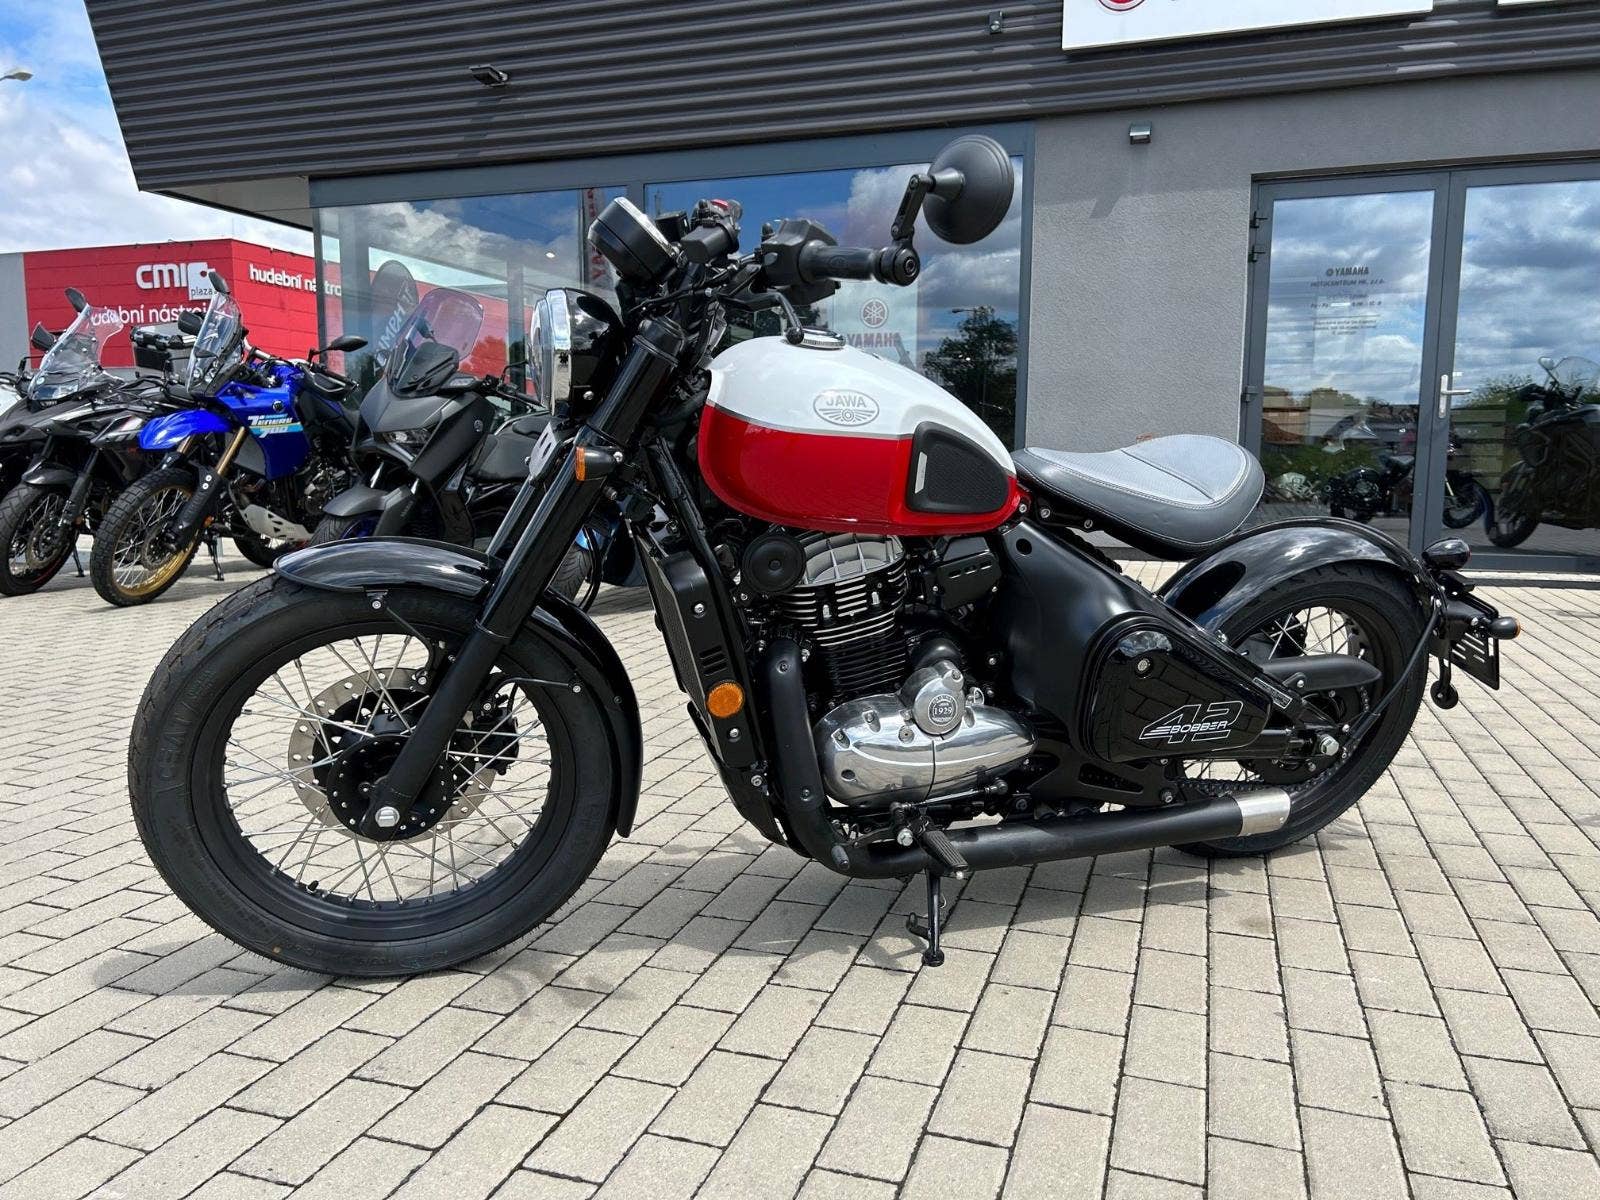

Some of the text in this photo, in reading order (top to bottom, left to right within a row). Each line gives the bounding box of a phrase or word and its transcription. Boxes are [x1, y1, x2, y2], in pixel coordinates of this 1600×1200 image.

[248, 263, 302, 290] hudební
[1335, 266, 1370, 276] YAMAHA
[826, 394, 868, 409] JAWA
[934, 706, 953, 715] 1929
[1138, 701, 1243, 744] 42
[1169, 720, 1228, 735] BOBBER
